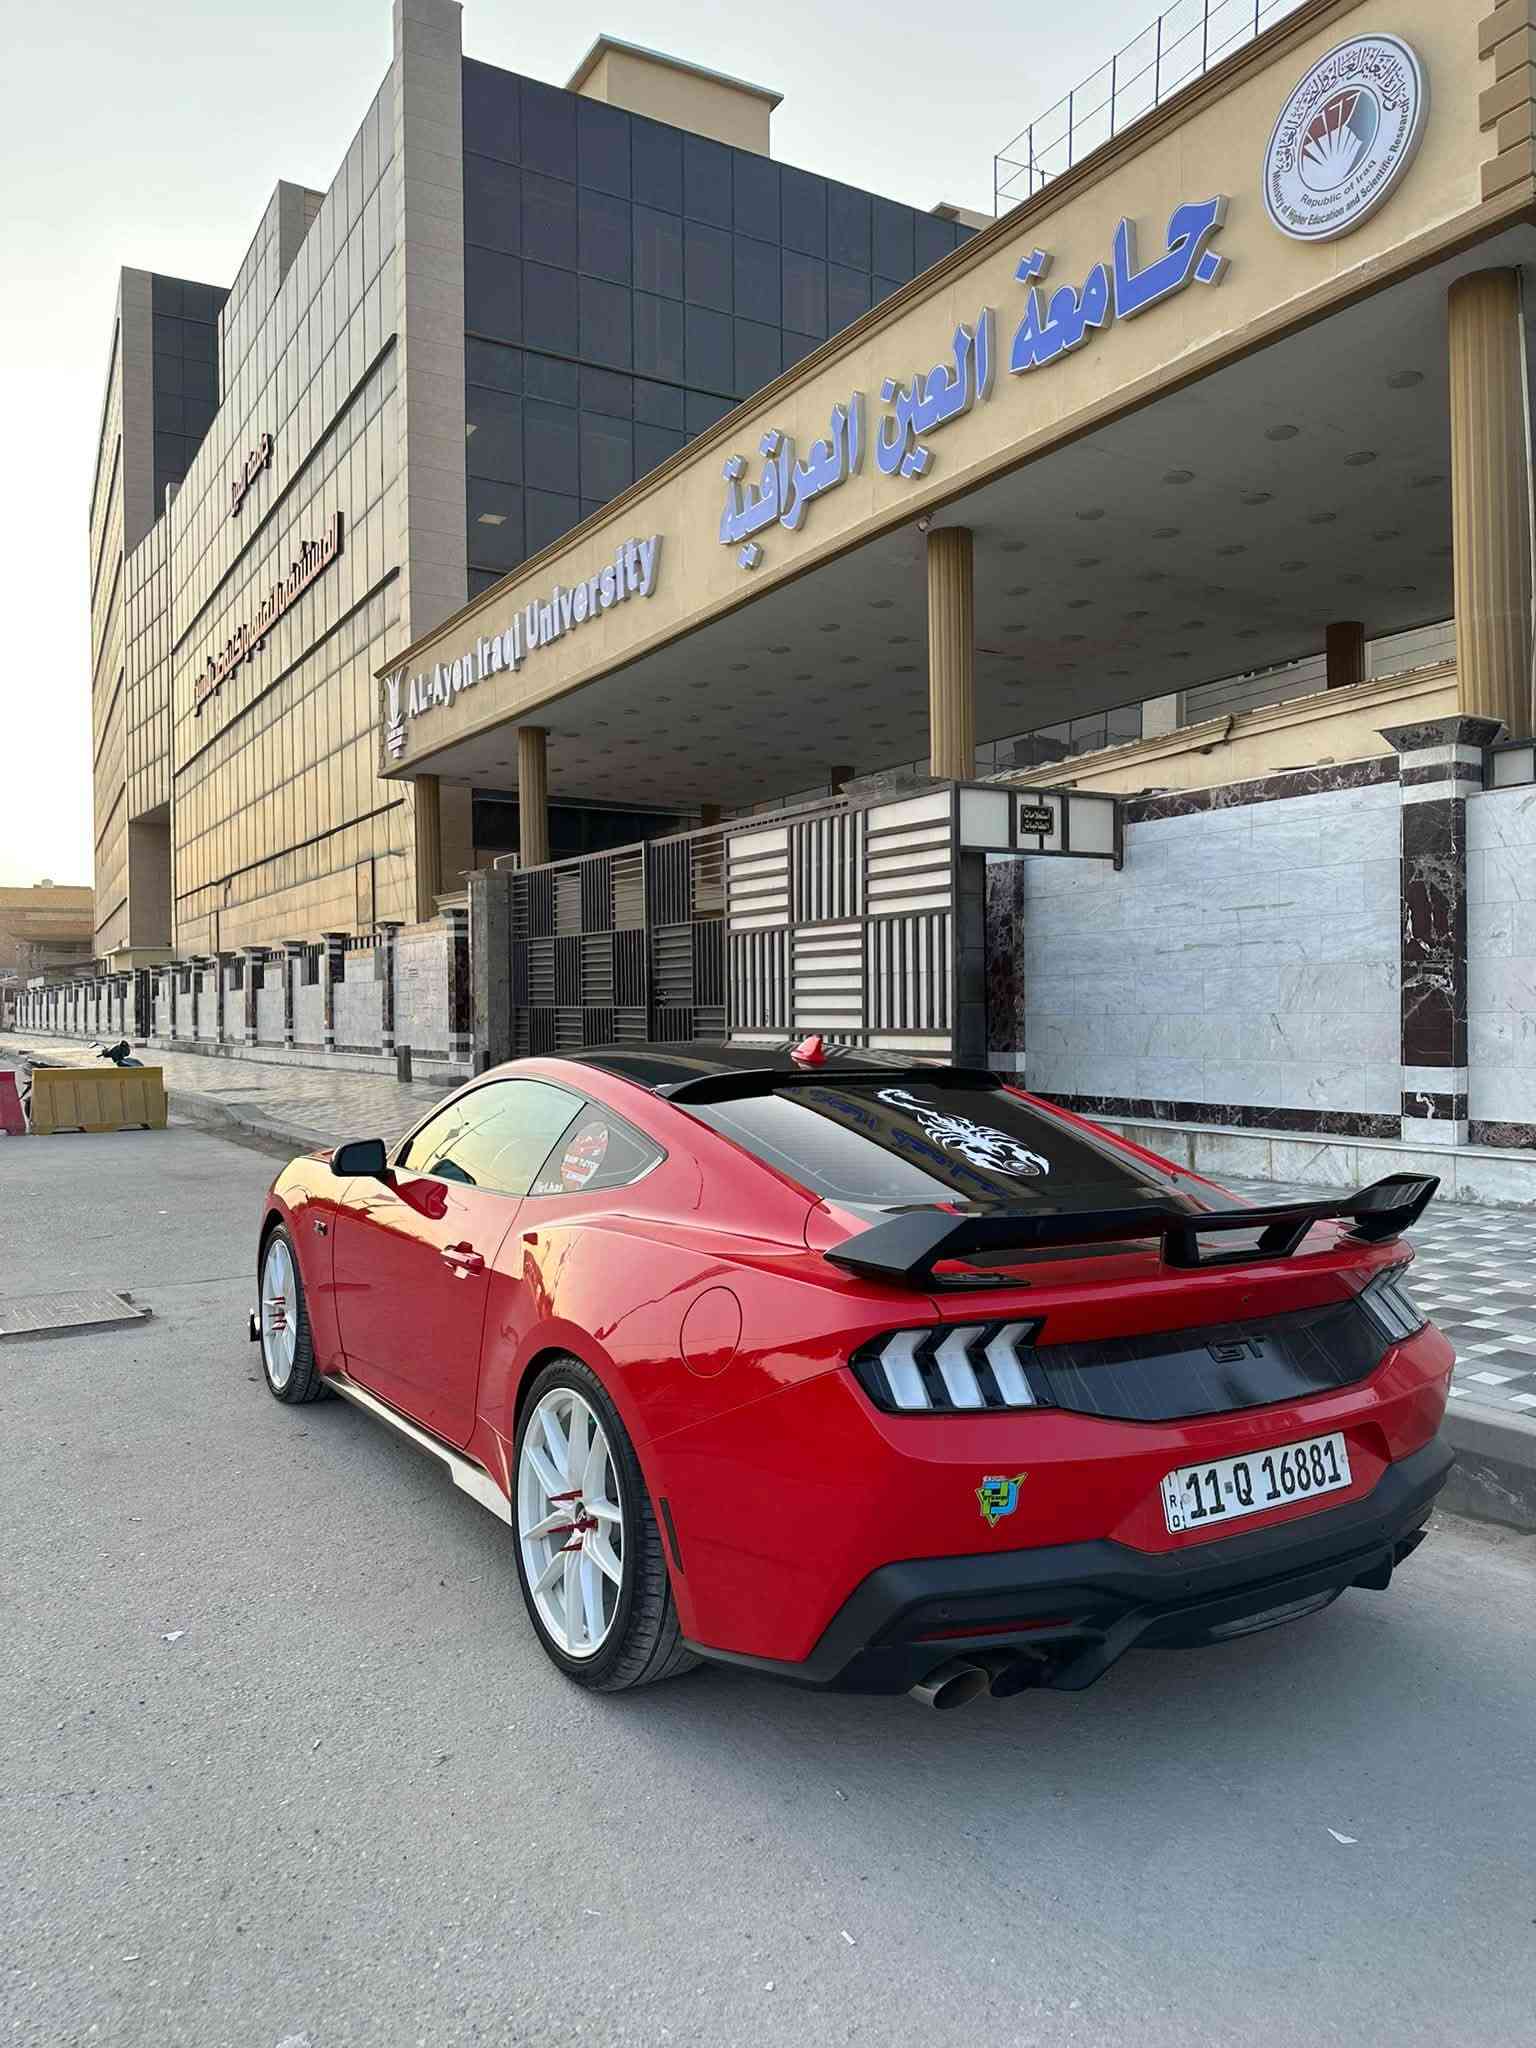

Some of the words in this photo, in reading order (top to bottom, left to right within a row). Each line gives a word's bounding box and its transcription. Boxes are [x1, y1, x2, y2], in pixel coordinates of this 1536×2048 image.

[1300, 193, 1341, 207] Republic
[1344, 181, 1355, 195] of
[1355, 160, 1377, 184] Iraq
[1308, 207, 1345, 225] Education
[1345, 193, 1360, 211] and
[1360, 155, 1394, 197] Scientific
[1390, 99, 1409, 153] Research
[1009, 194, 1230, 375] جامعة
[876, 306, 996, 481] العين
[720, 391, 866, 568] العراقية
[477, 612, 524, 679] Iraqi
[526, 534, 663, 650] University
[1262, 1440, 1342, 1500] 16881
